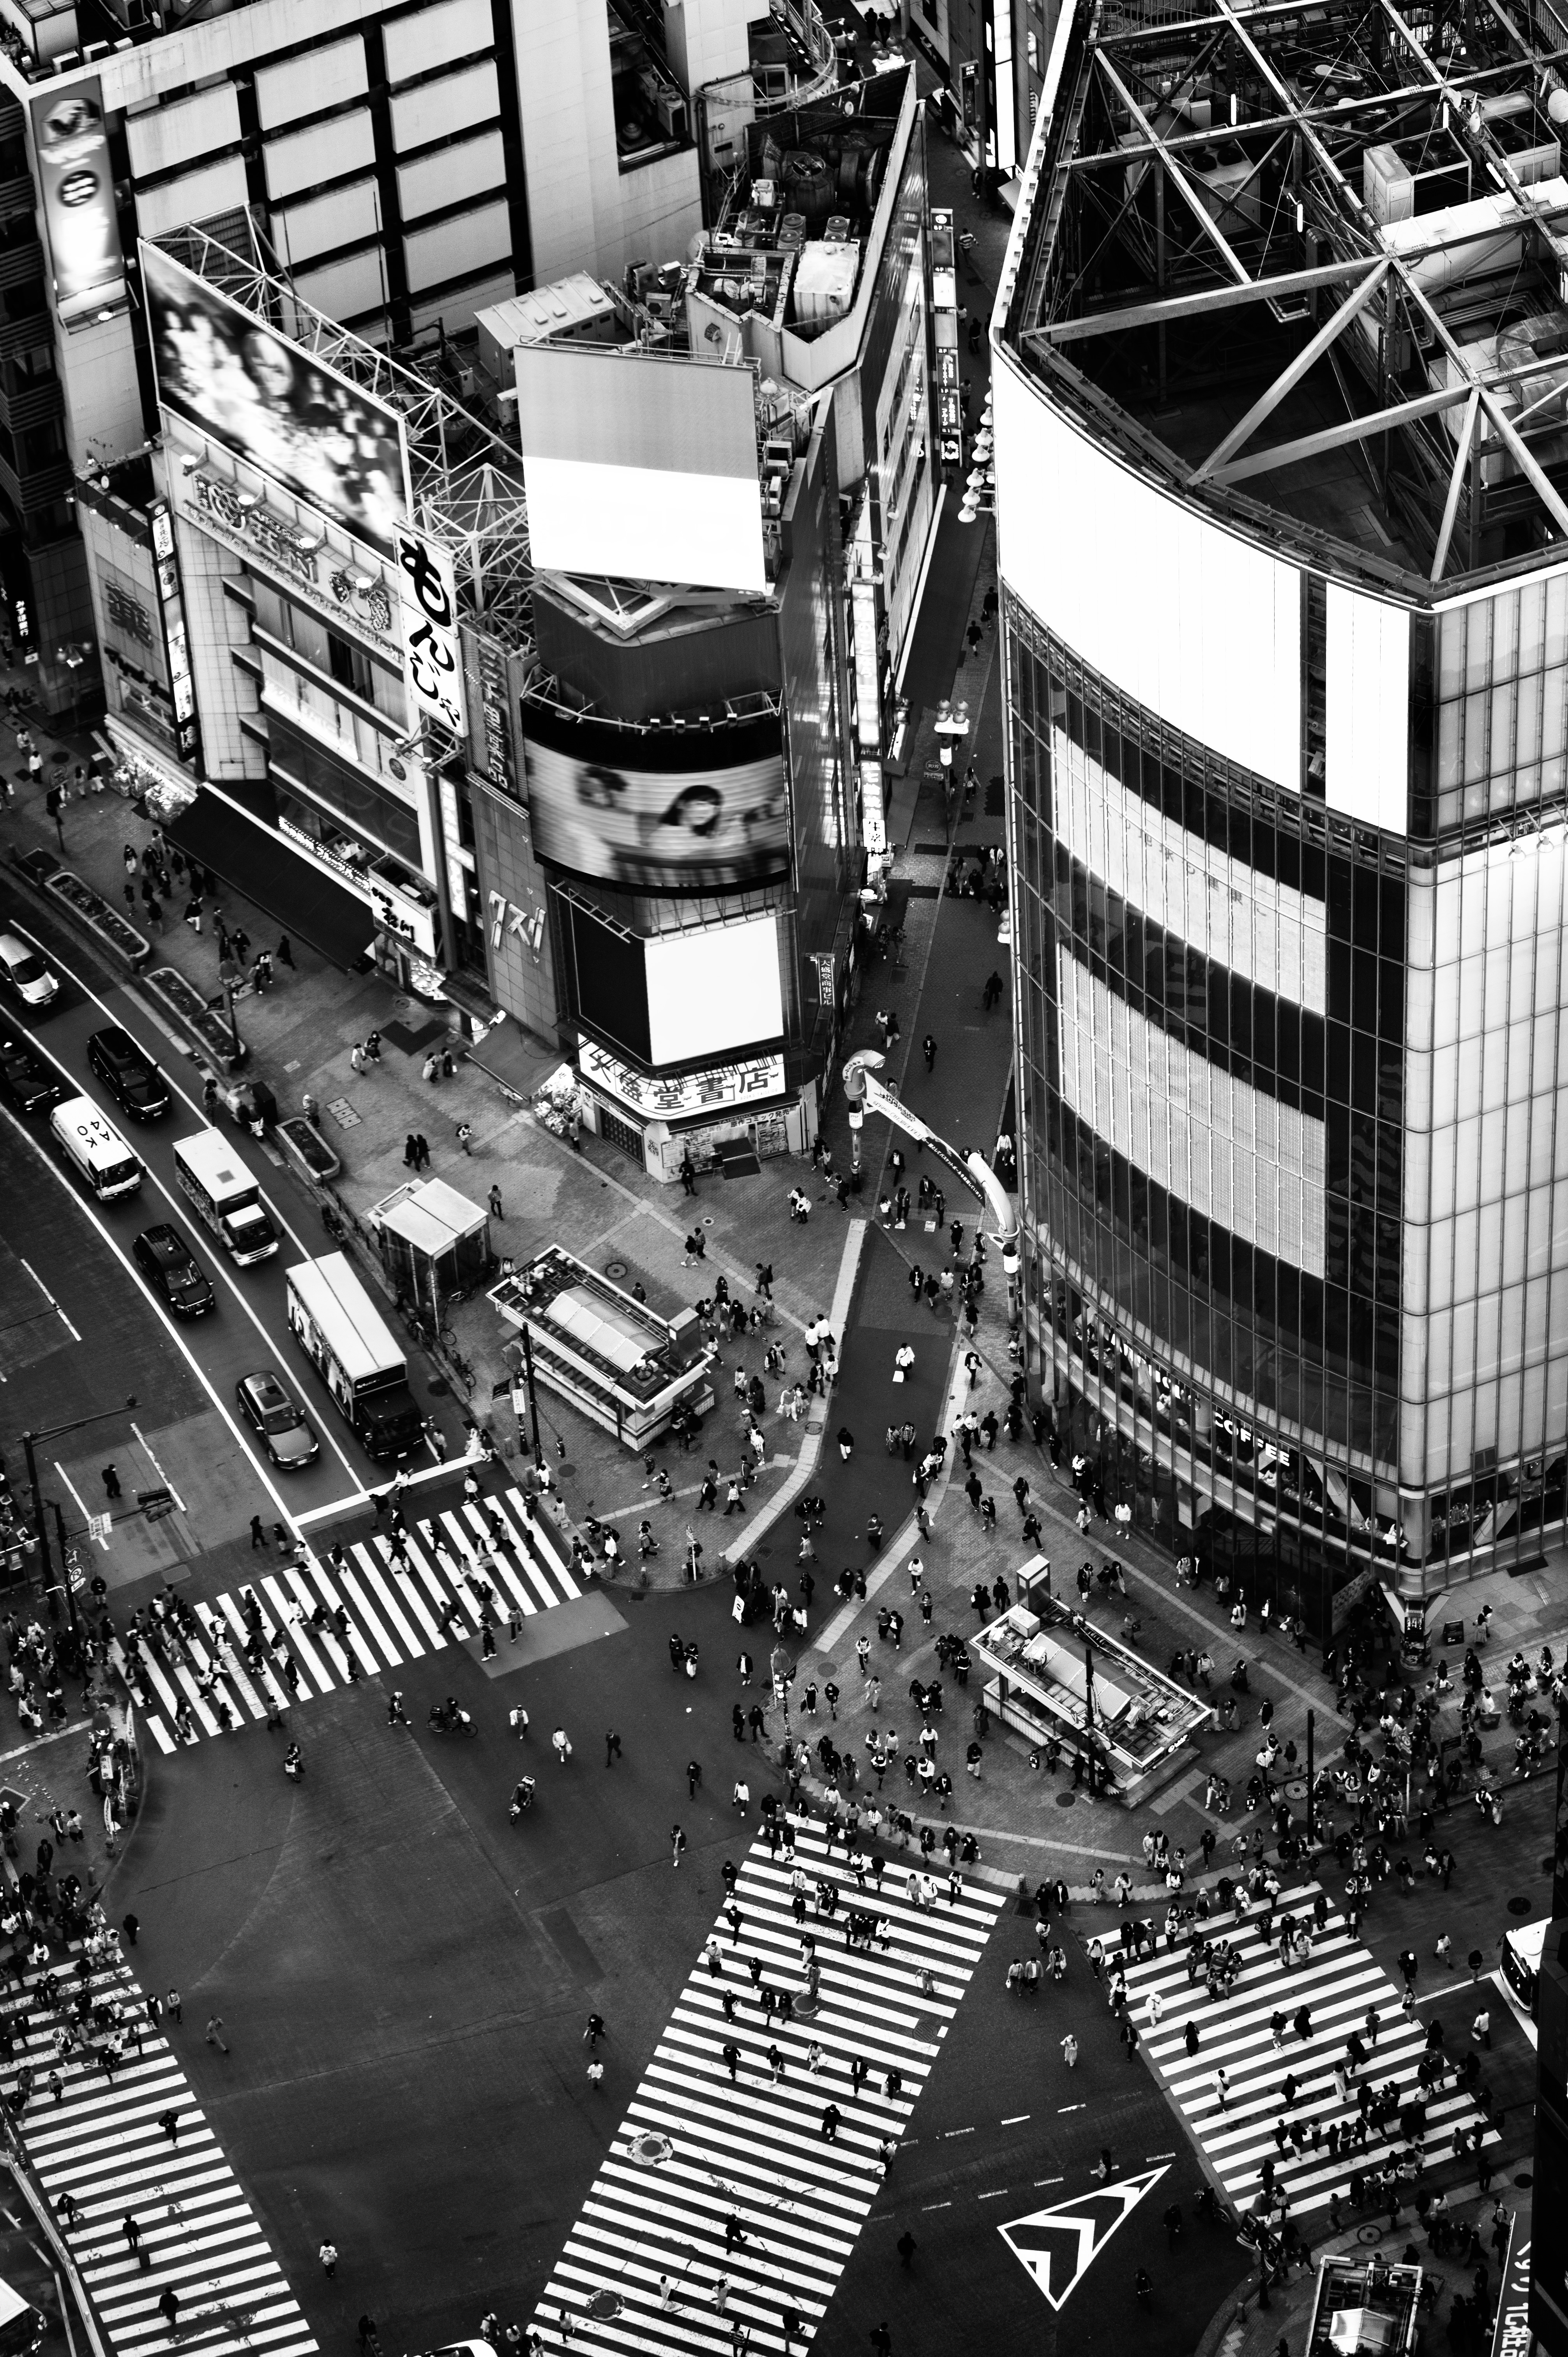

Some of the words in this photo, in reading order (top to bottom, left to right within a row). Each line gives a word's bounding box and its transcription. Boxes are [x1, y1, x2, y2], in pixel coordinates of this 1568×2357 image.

[398, 537, 461, 728] もんじゃ
[488, 890, 546, 953] クスリ
[820, 959, 833, 1006] 大盛堂商事ビル
[590, 1054, 773, 1111] 大盛堂書店
[718, 1114, 752, 1125] TAISEIDO
[730, 1109, 790, 1128] 原作コミック発売
